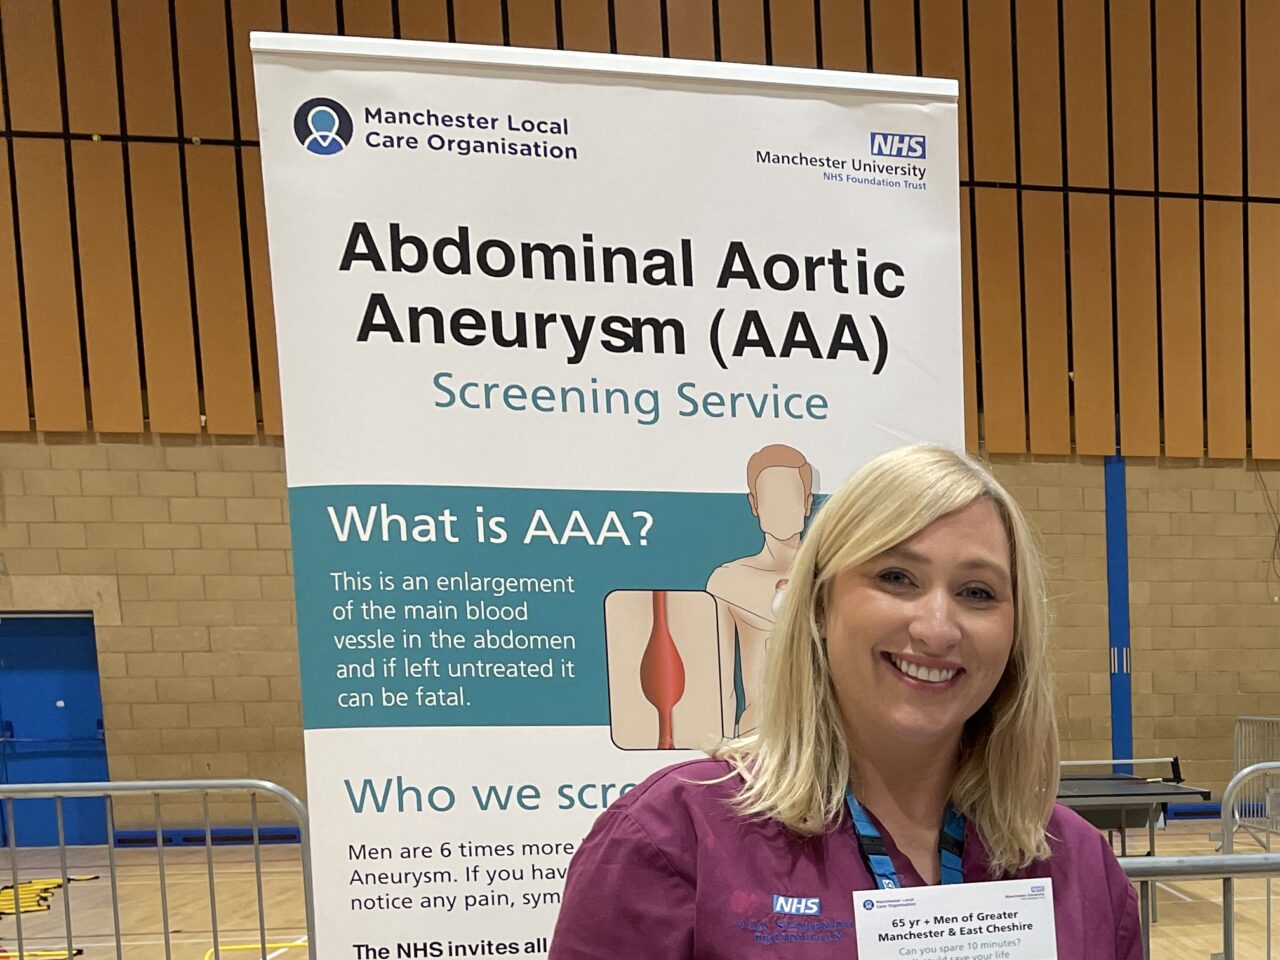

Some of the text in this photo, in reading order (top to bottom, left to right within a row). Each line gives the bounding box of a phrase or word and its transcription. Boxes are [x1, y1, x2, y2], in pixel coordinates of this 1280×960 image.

[364, 106, 569, 135] Manchester Local
[365, 131, 578, 160] Care Organisation
[873, 133, 924, 158] NHS
[755, 149, 927, 179] Manchester University
[823, 172, 927, 190] NHS Foundation Trust
[339, 221, 907, 298] Abdominal Aortic
[357, 292, 890, 375] Aneurysm (AAA)
[432, 372, 829, 425] Screening Service
[327, 504, 654, 546] What is AAA?
[330, 572, 575, 596] This is an enlargement
[332, 601, 528, 621] of the main blood
[334, 630, 576, 650] vessle in the abdomen
[337, 658, 575, 679] and if left untreated it
[338, 687, 471, 708] can be fatal.
[345, 776, 456, 814] Who
[472, 781, 541, 811] we
[348, 840, 575, 861] Men are 6 times more
[350, 863, 566, 889] Aneurysm. If you hav
[351, 890, 561, 912] notice any pain, sym
[776, 897, 820, 913] NHS
[892, 919, 905, 928] 65
[909, 918, 921, 929] yr
[934, 916, 958, 925] Men
[962, 913, 974, 922] of
[977, 911, 1018, 922] Greater
[878, 930, 945, 942] Manchester
[960, 926, 983, 935] East
[987, 922, 1033, 933] Cheshire
[353, 937, 548, 960] The NHS invites all
